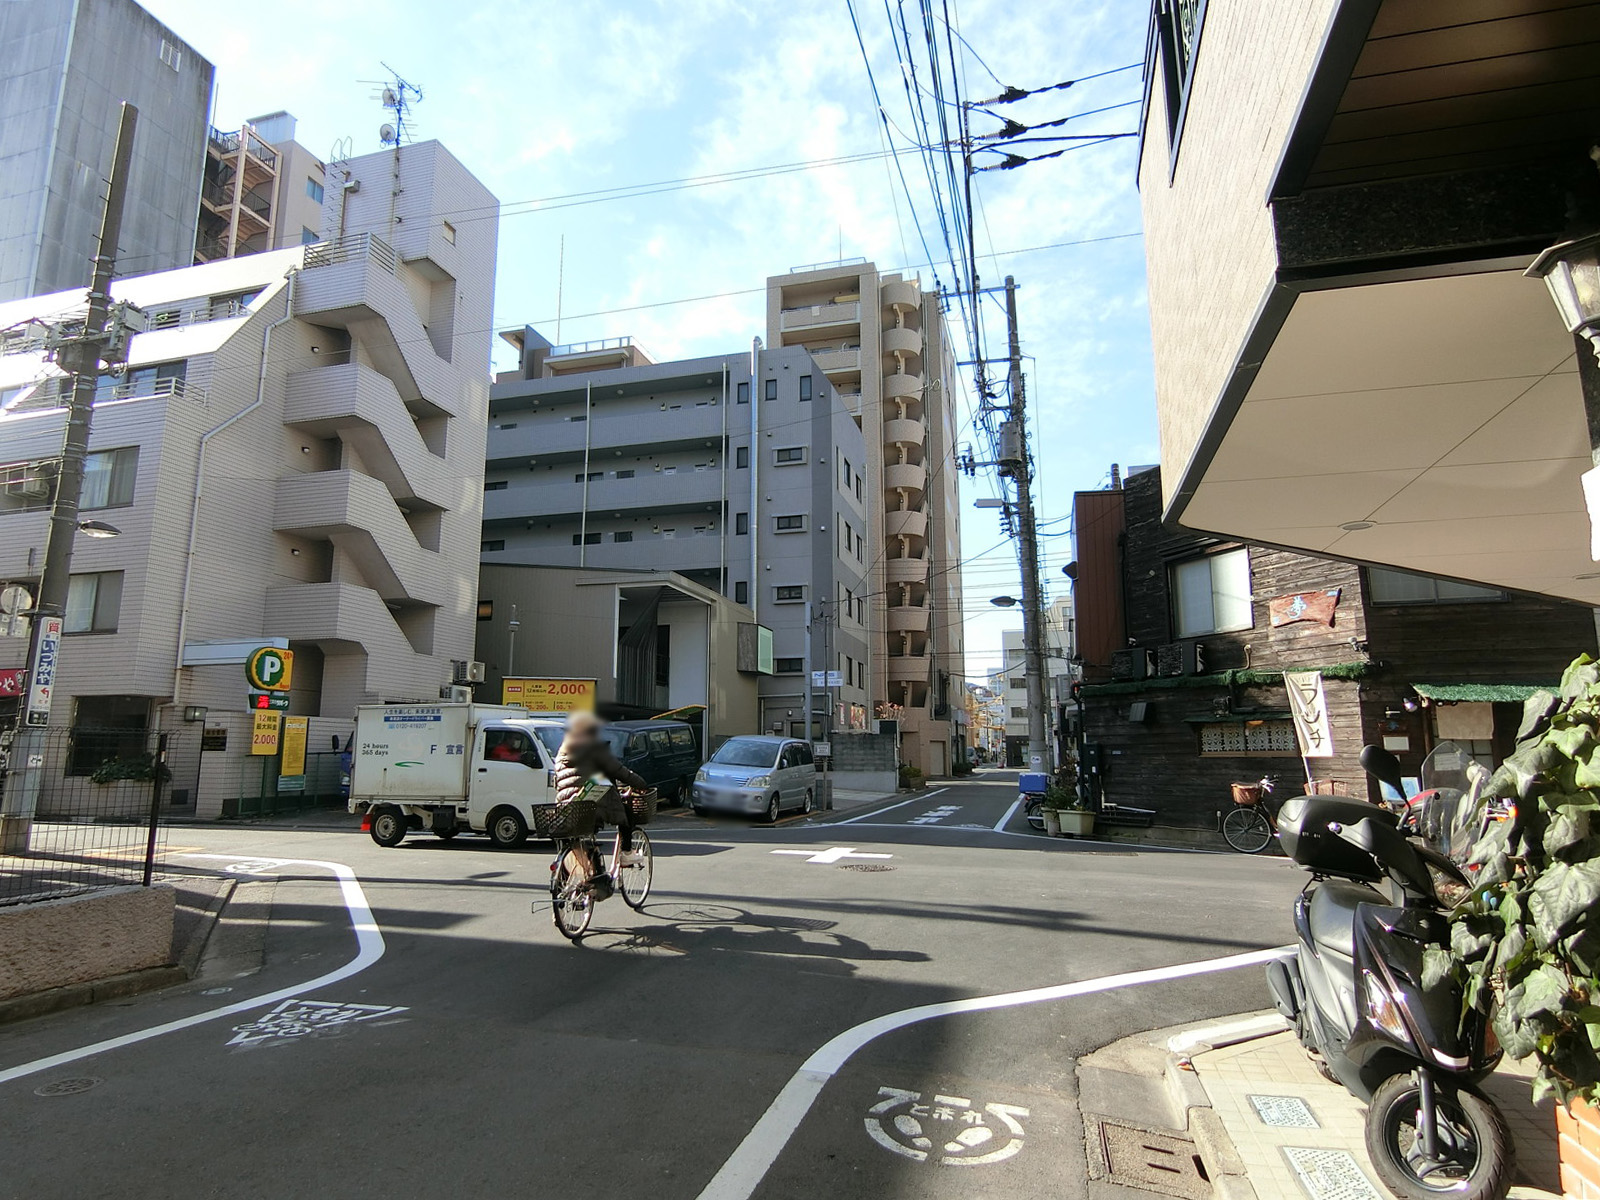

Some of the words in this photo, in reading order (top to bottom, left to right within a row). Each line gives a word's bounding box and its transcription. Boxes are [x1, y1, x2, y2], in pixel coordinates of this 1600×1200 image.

[37, 640, 55, 685] いづみや
[263, 655, 281, 681] P
[1300, 683, 1325, 749] ランチ
[374, 749, 389, 757] days
[430, 744, 438, 755] F
[446, 744, 464, 755] 宣言
[909, 1103, 985, 1124] とまれ
